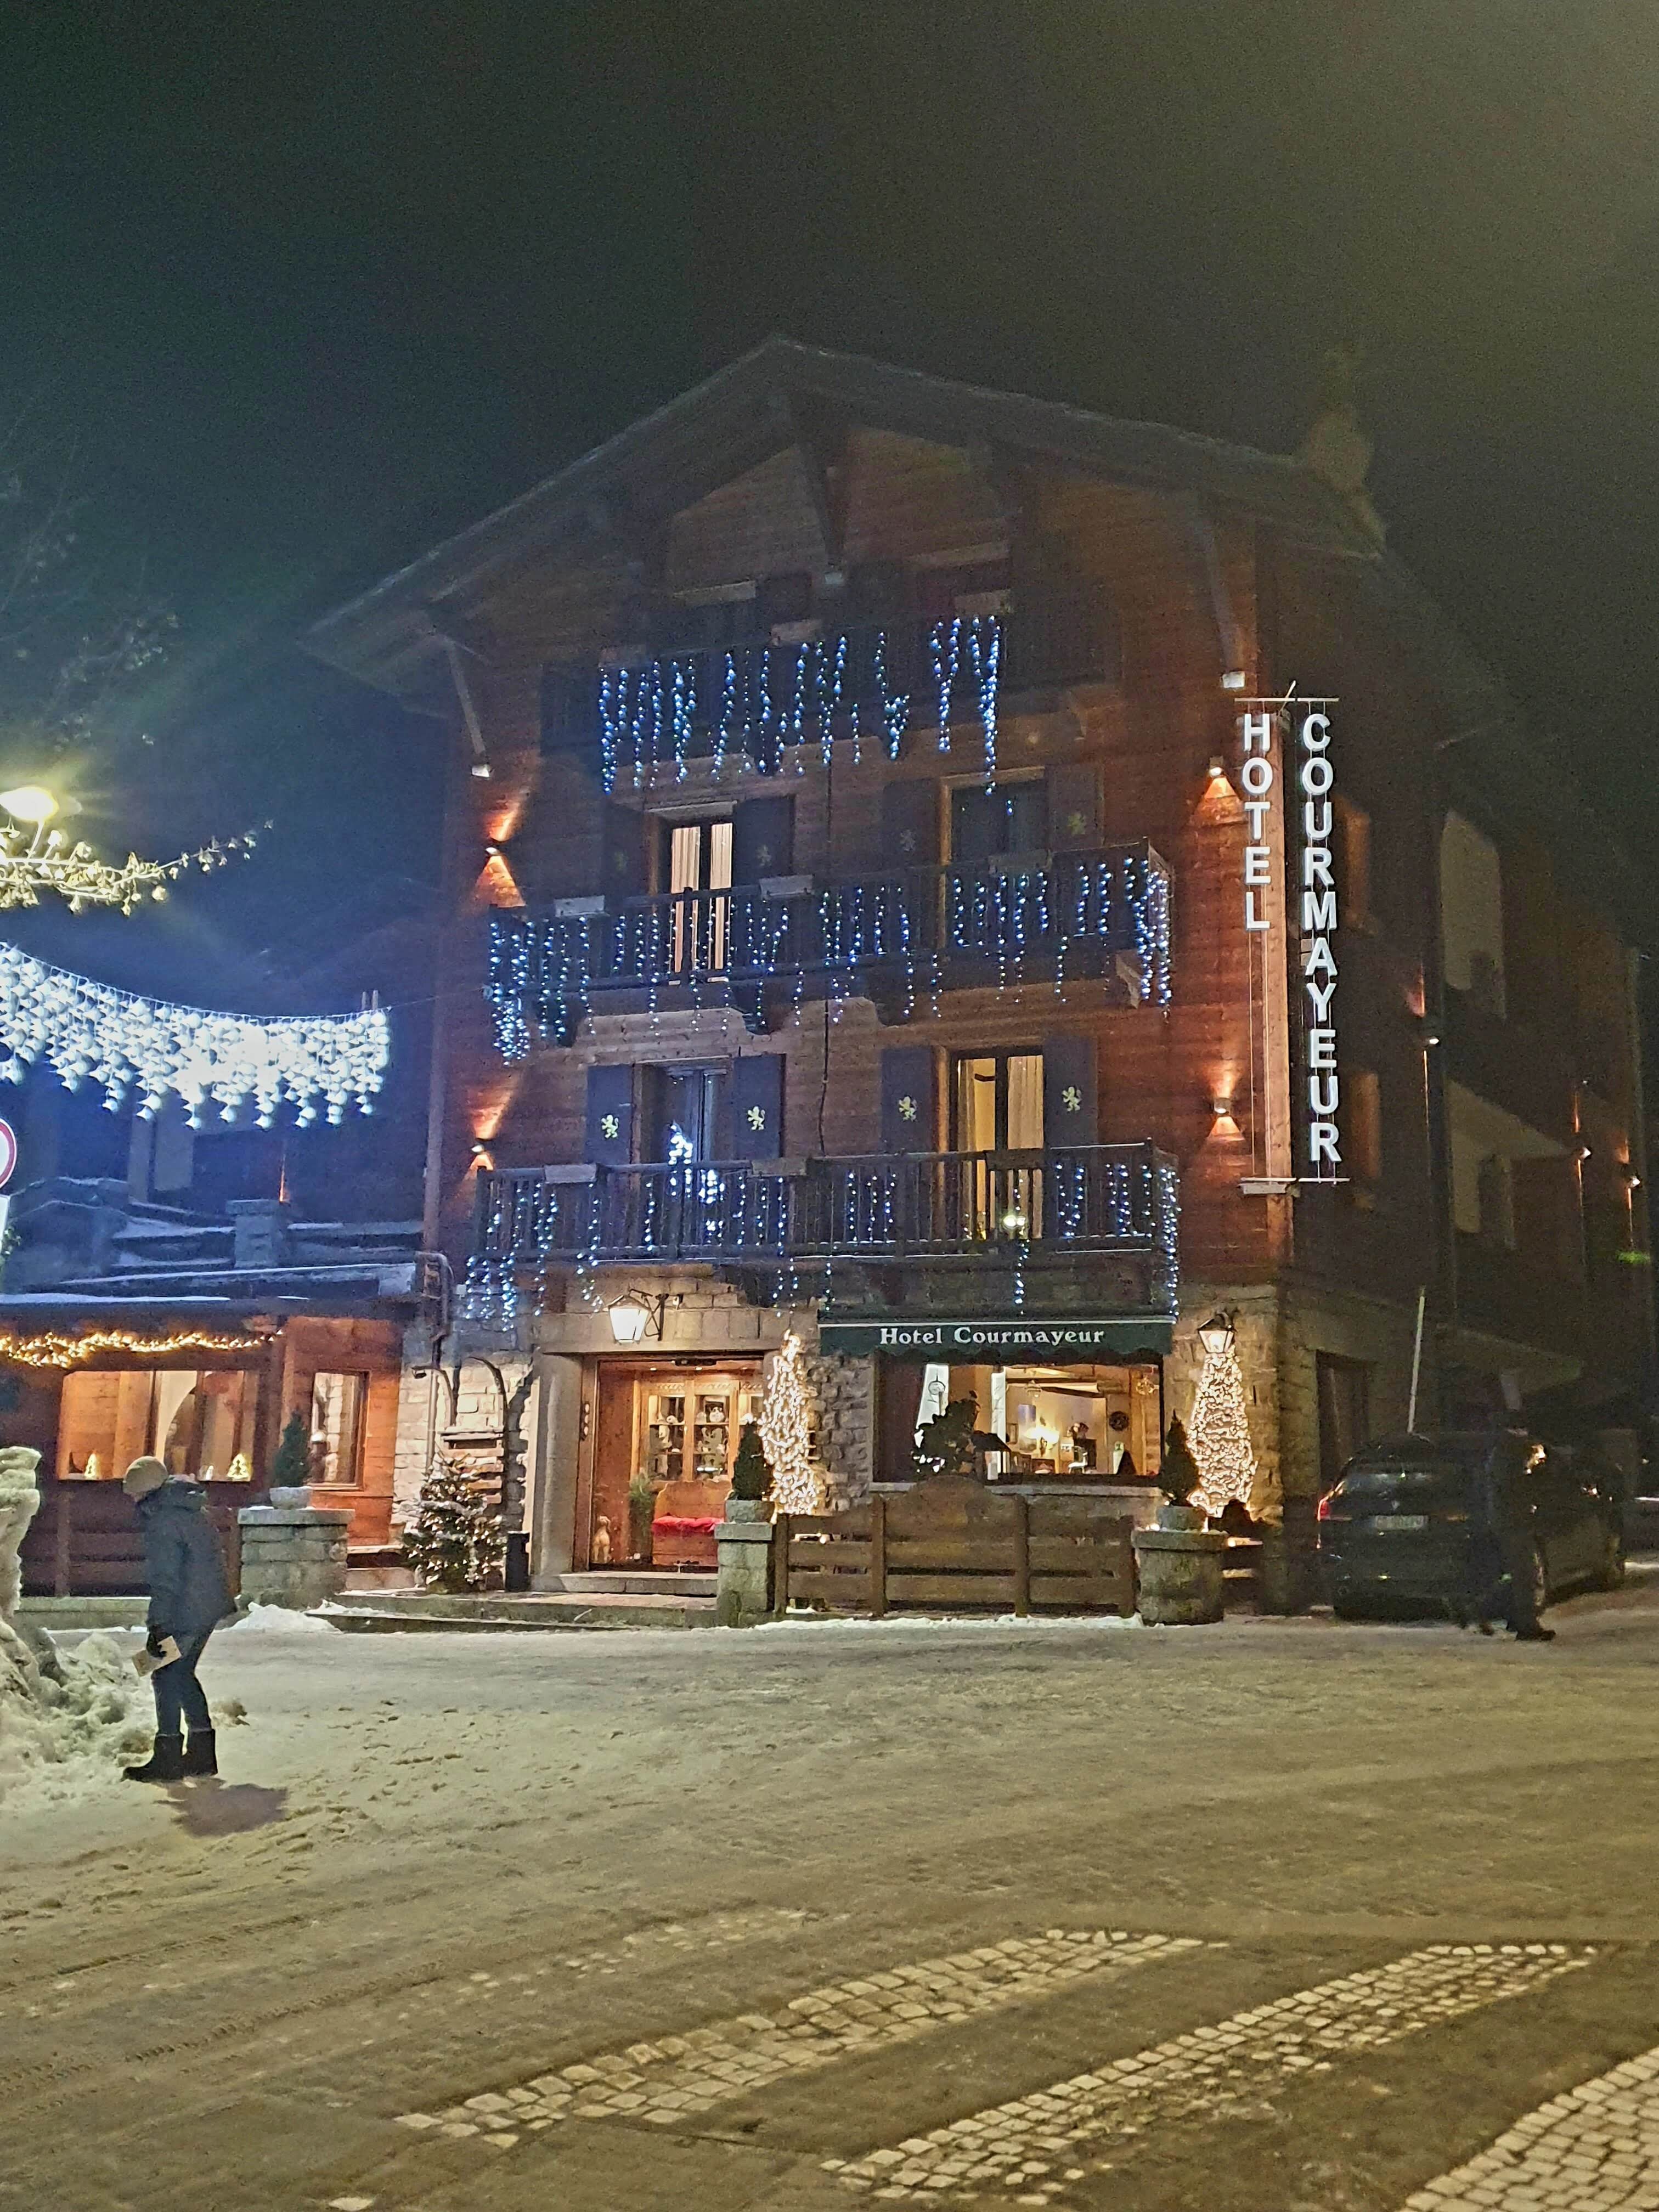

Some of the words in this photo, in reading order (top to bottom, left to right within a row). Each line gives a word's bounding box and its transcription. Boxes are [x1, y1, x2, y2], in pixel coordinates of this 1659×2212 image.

[1242, 713, 1274, 931] HOTEL
[1301, 713, 1342, 1163] COURMAYEUR
[880, 1327, 943, 1345] Hotel
[954, 1327, 1104, 1346] Courmayeur
